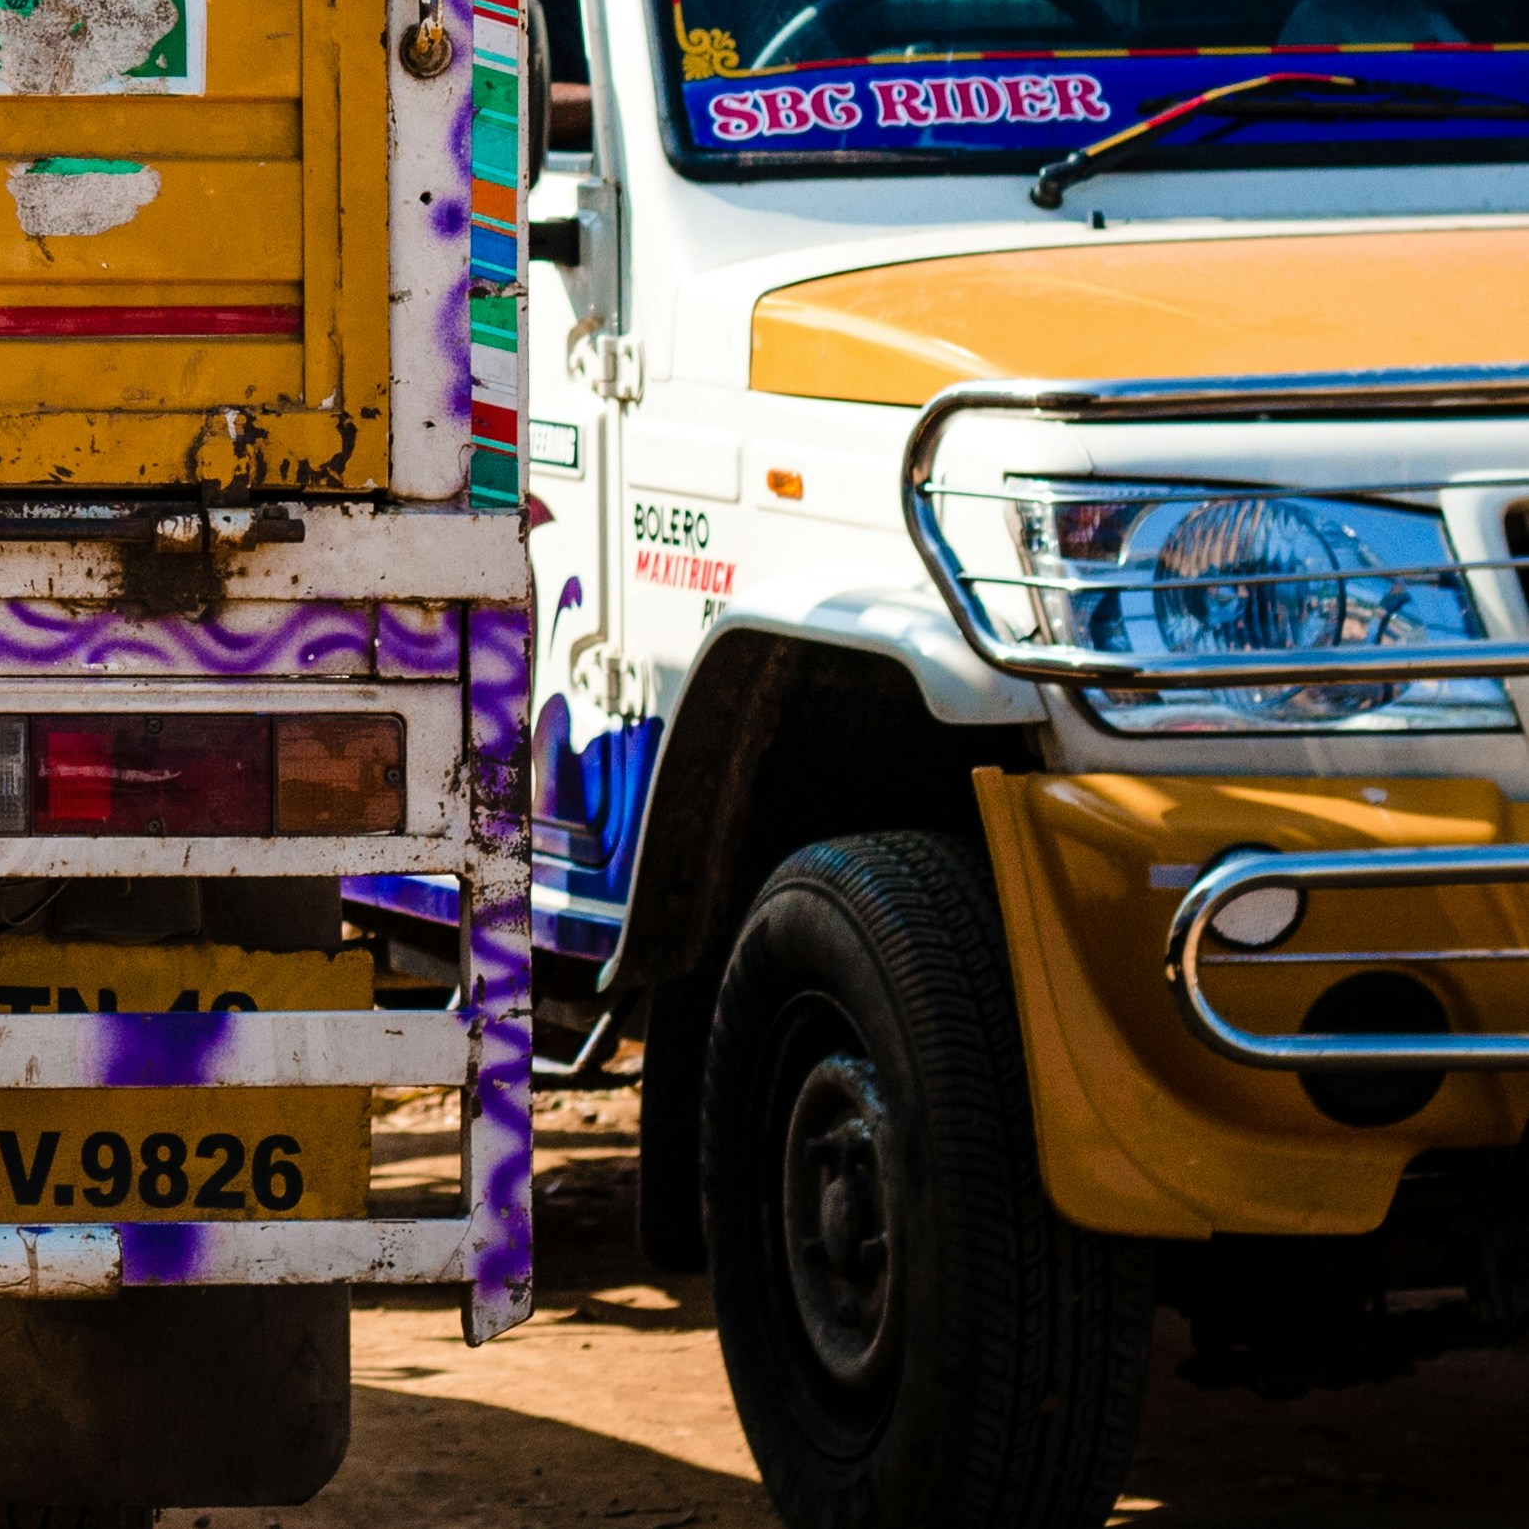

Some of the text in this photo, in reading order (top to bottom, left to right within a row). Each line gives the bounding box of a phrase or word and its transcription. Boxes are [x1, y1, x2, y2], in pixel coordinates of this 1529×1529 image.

[870, 74, 1111, 127] RIDER
[633, 502, 710, 554] BOLERO
[635, 549, 737, 595] MAXITRUCK
